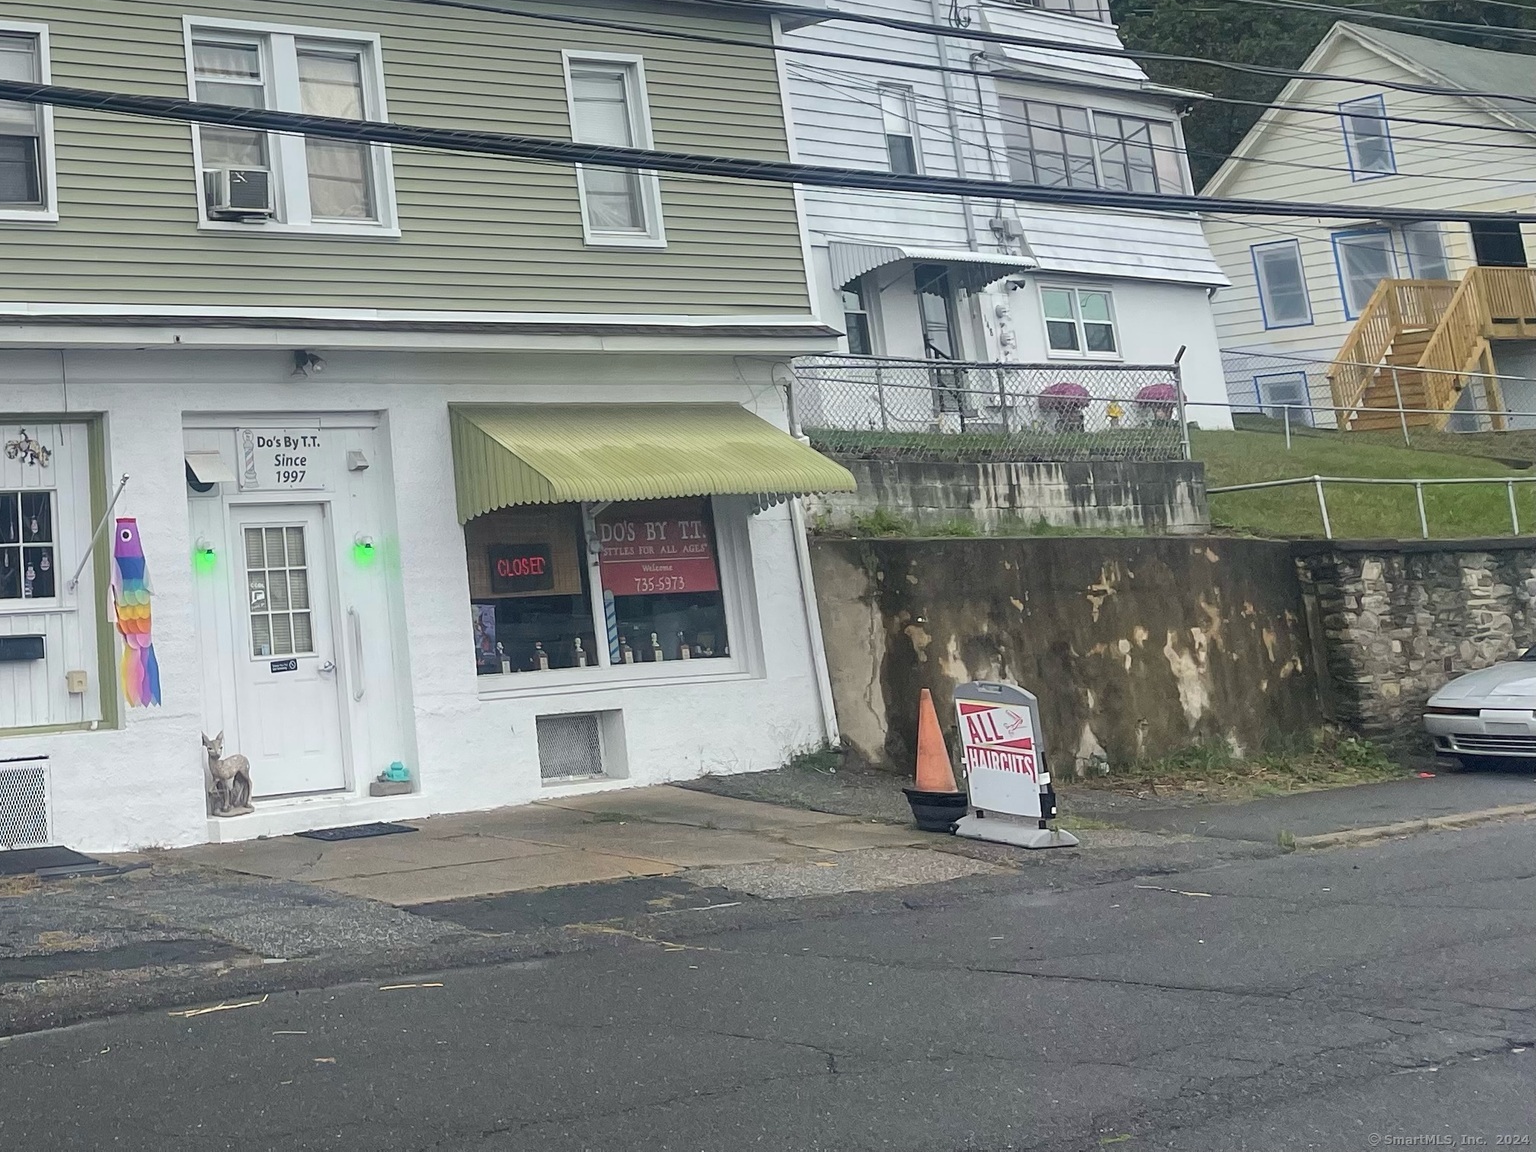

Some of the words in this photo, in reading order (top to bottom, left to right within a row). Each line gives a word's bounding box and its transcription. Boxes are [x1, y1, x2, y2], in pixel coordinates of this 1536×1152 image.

[257, 436, 281, 448] Do's
[284, 436, 299, 450] By
[301, 436, 321, 448] T.T.
[274, 454, 307, 467] Since
[276, 470, 306, 483] 1997
[600, 521, 636, 543] DO'S
[645, 521, 668, 541] BY
[678, 520, 707, 540] T.T.
[638, 546, 655, 555] FOR
[660, 545, 678, 554] ALL
[497, 557, 546, 577] CLOSED
[642, 564, 673, 572] Welcome
[634, 576, 685, 592] 735-5973
[966, 712, 1004, 745] ALL
[967, 747, 1037, 784] HAIRCUTS
